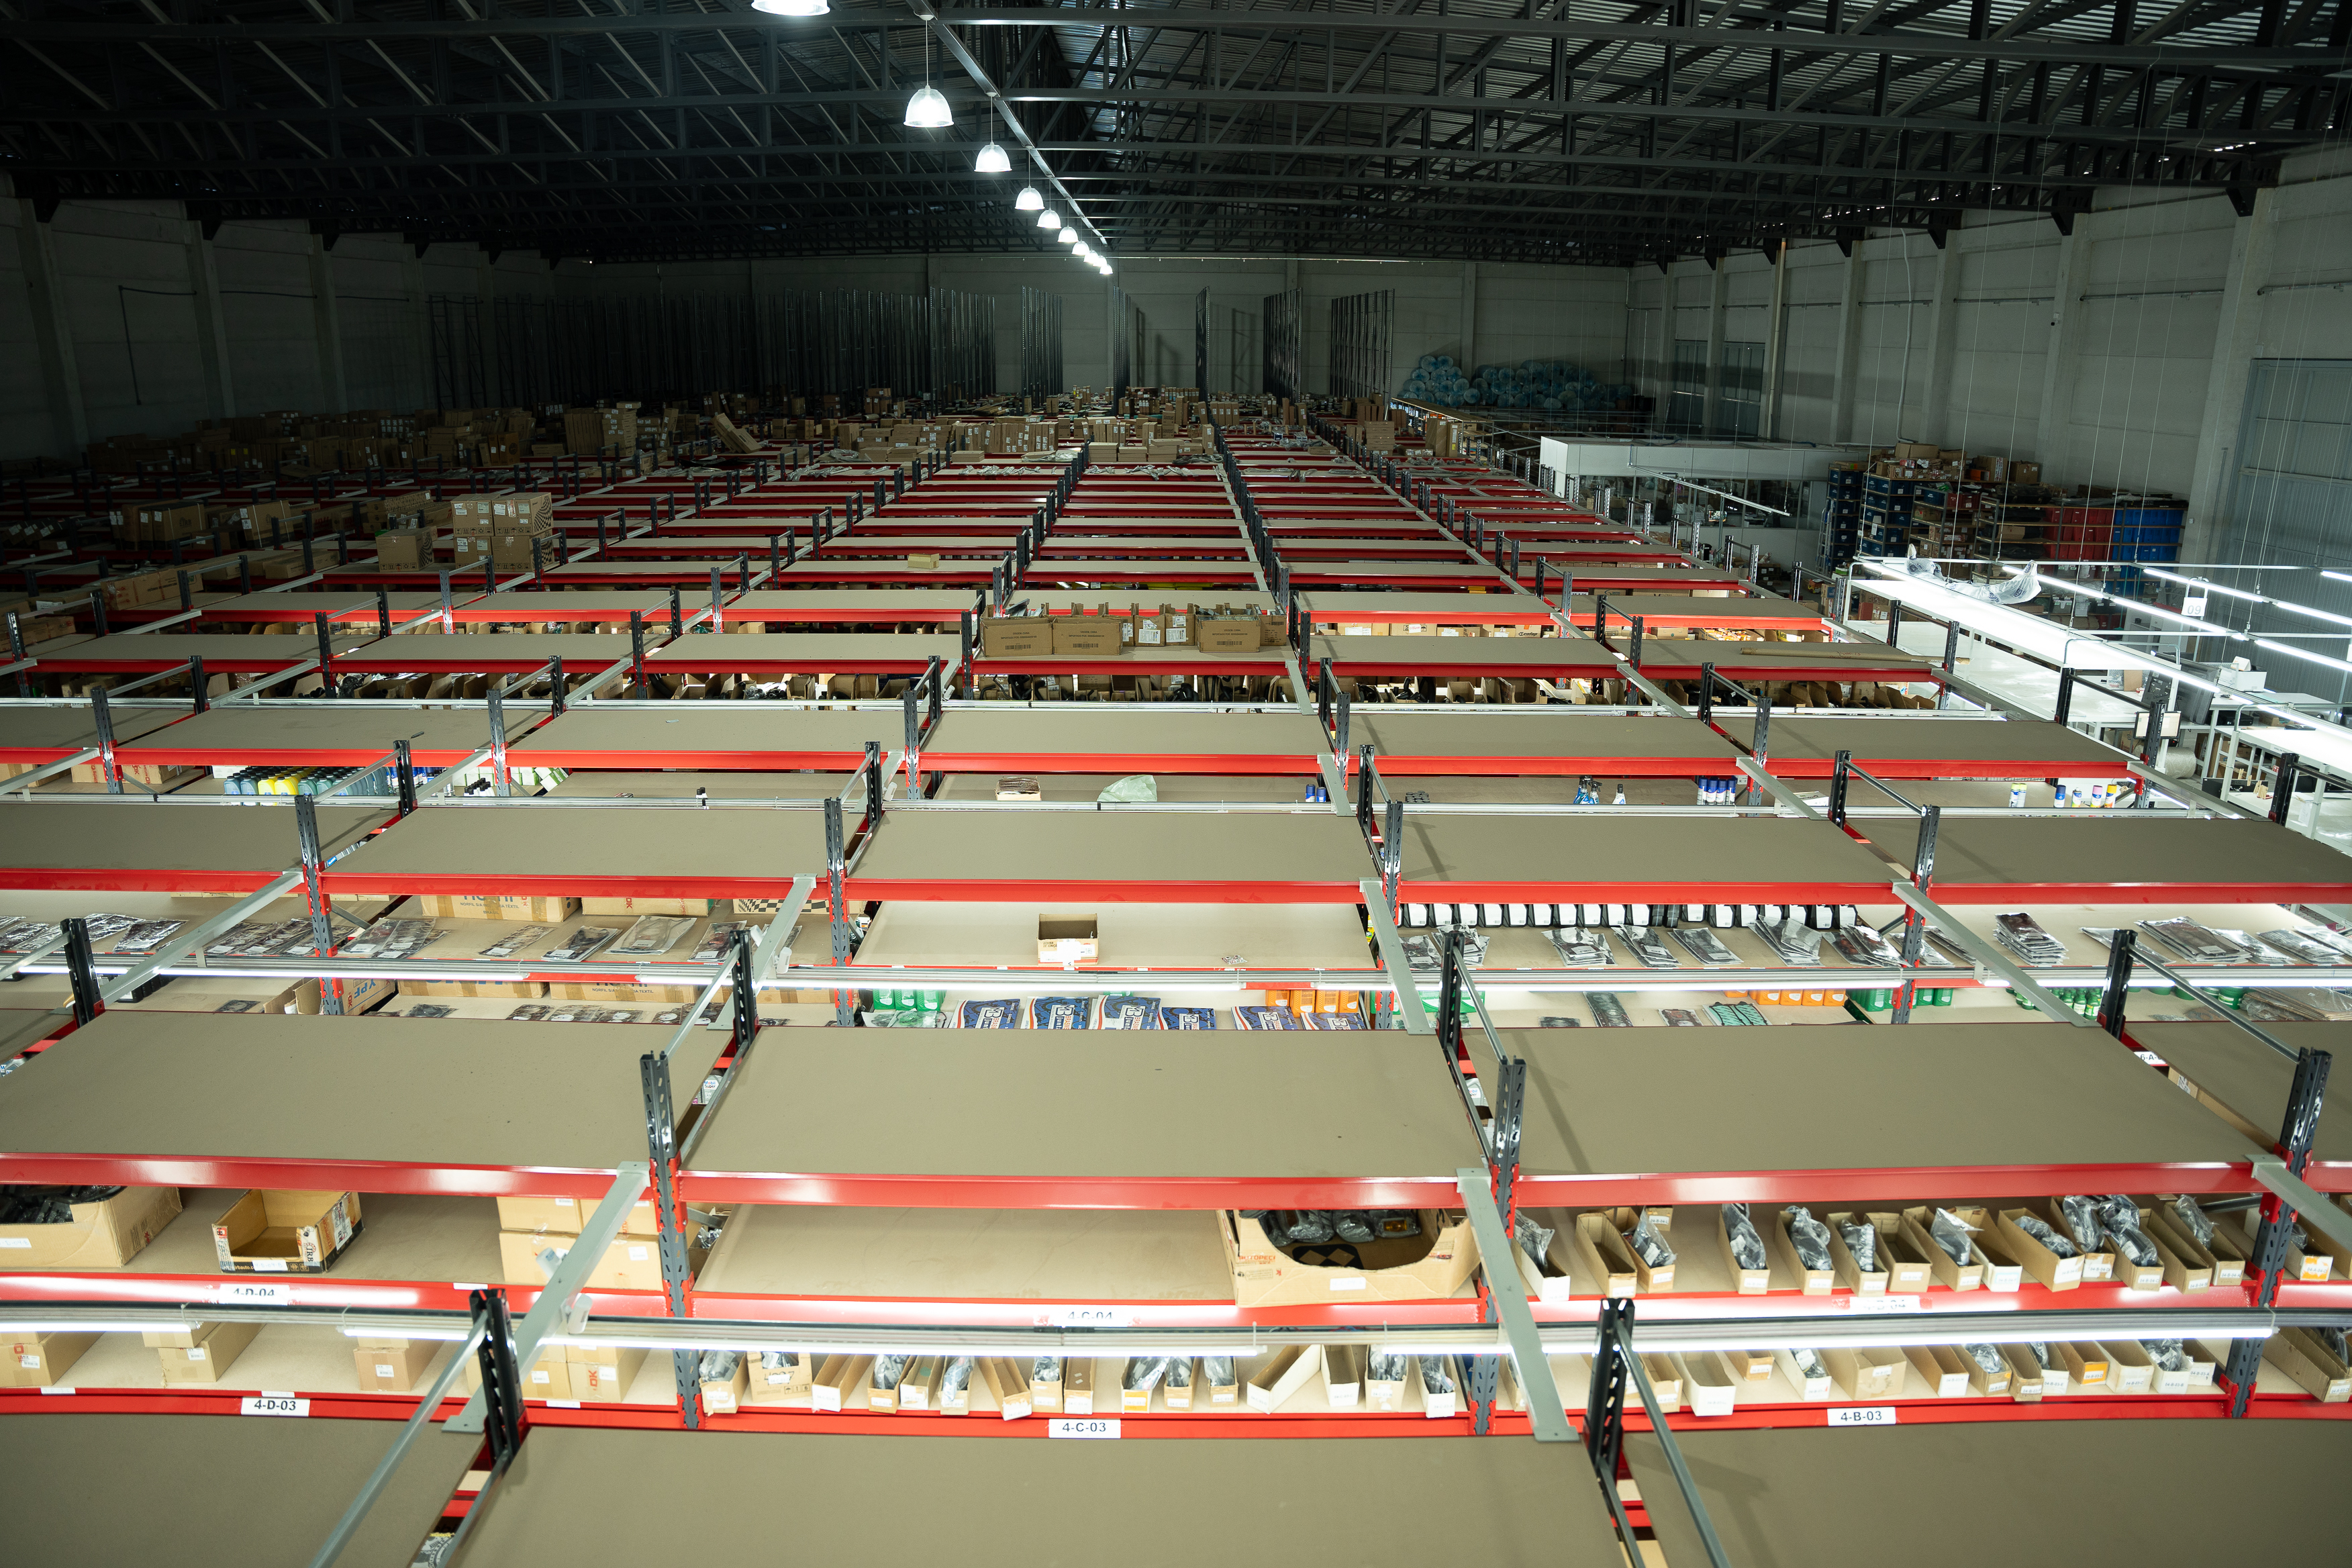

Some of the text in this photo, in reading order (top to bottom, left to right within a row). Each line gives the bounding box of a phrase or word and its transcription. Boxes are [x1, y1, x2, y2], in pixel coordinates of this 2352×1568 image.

[2187, 605, 2202, 615] 09
[306, 1248, 314, 1263] IRB
[254, 1399, 297, 1411] 4-D-03
[1841, 1410, 1882, 1422] 4-B-03
[1062, 1422, 1107, 1432] 4-C-03
